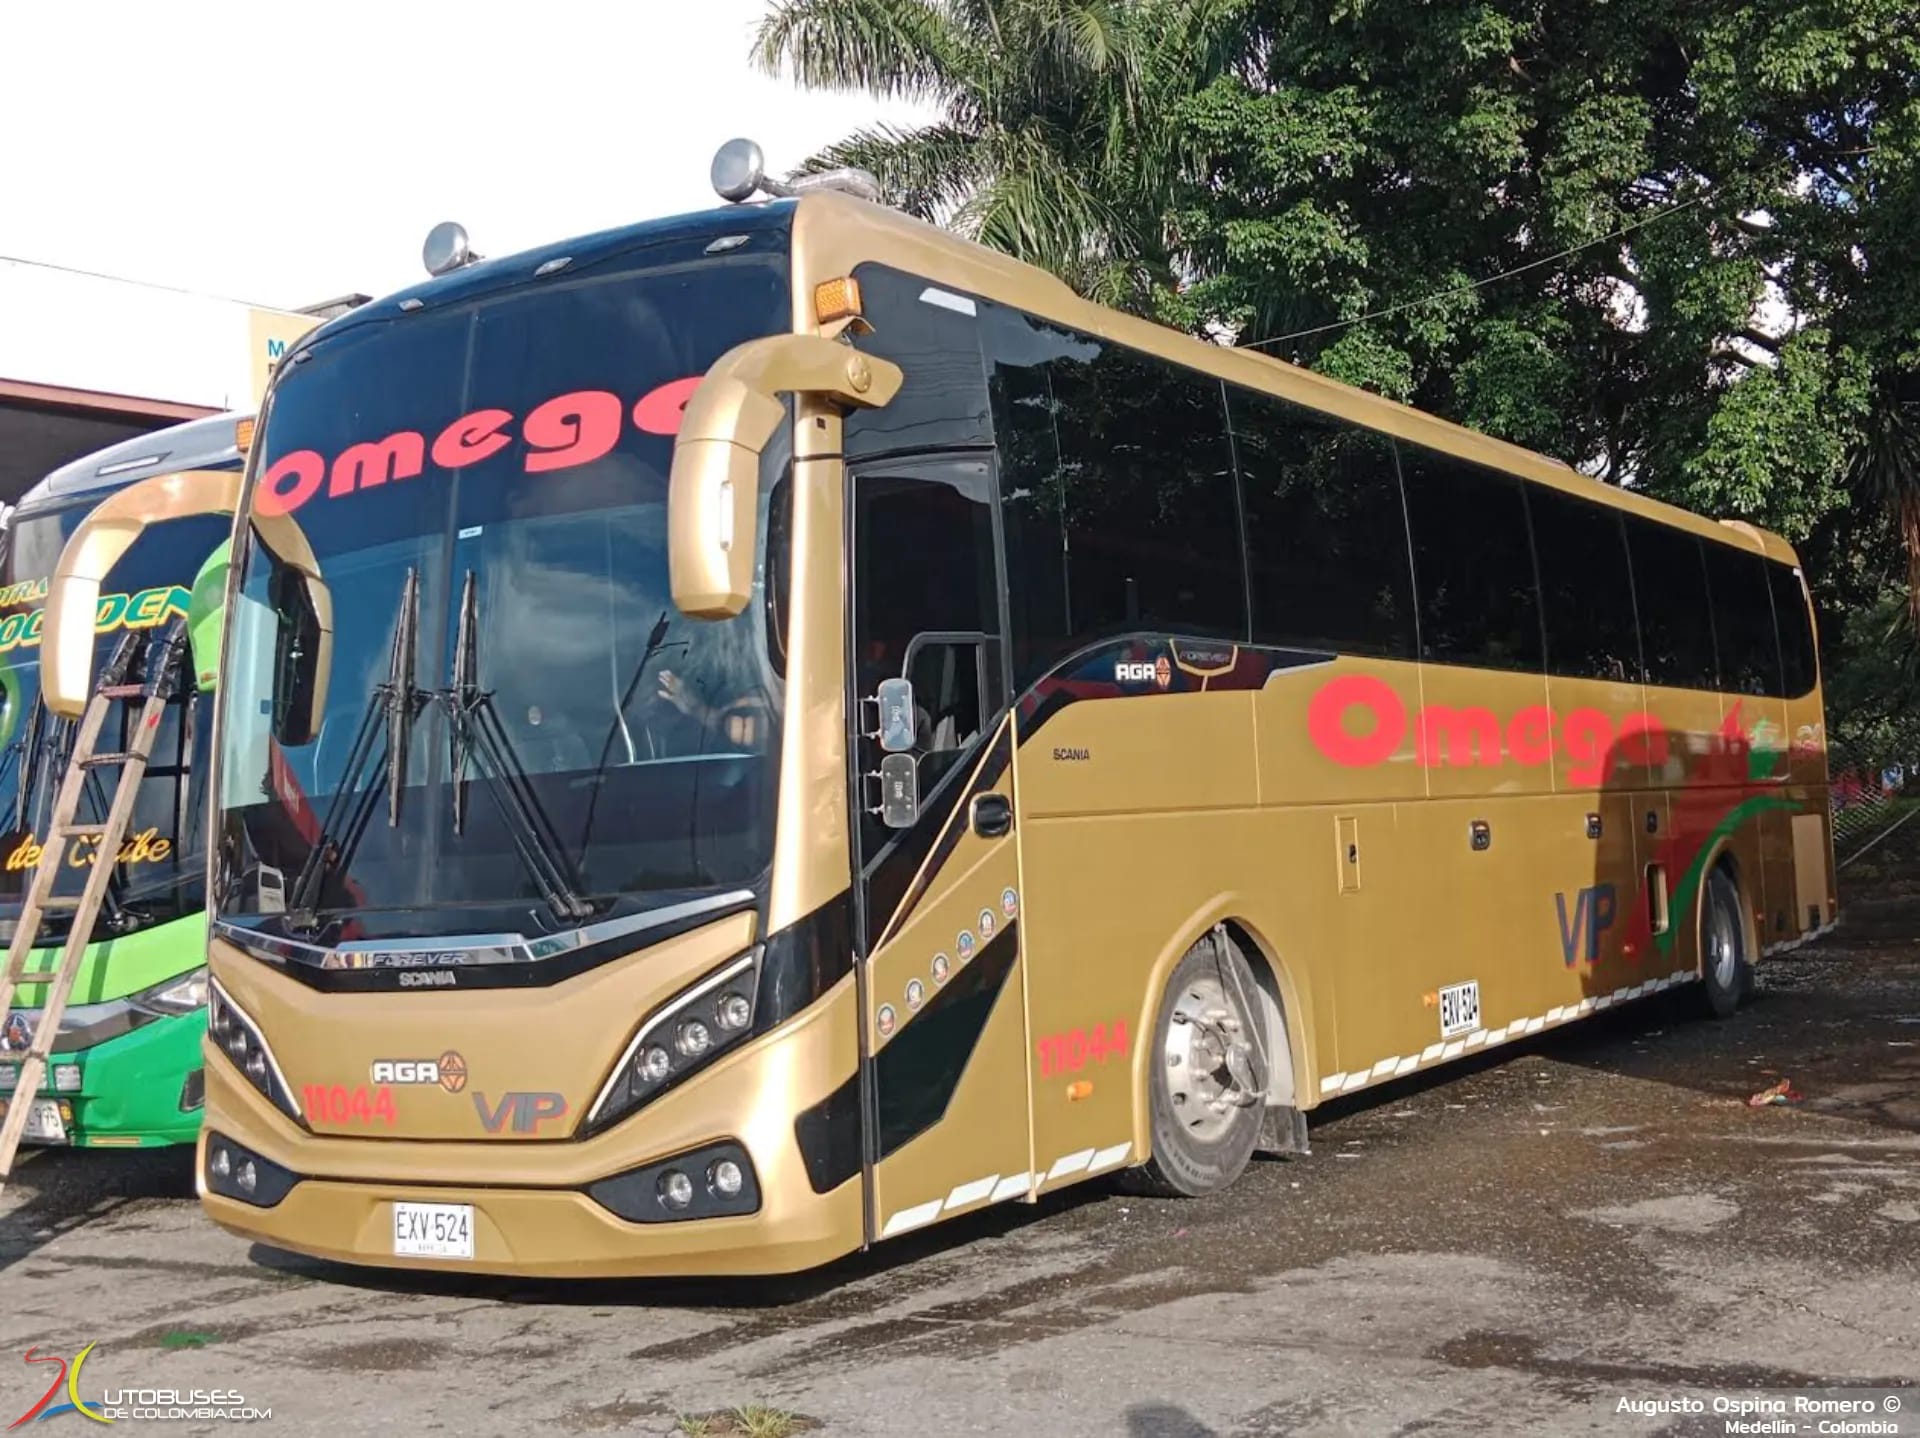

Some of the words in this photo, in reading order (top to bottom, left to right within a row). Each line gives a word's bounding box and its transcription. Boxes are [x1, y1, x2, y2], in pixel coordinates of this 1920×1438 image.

[1115, 663, 1156, 681] AGA
[1307, 673, 1669, 788] Omega
[1053, 748, 1090, 761] SCANIA
[1555, 884, 1617, 968] VIP
[374, 952, 469, 967] FOREVER
[399, 970, 456, 986] SCANIA
[1037, 1019, 1130, 1079] 11044
[373, 1061, 439, 1083] AGA
[303, 1083, 399, 1127] 11044
[472, 1091, 569, 1134] VIP
